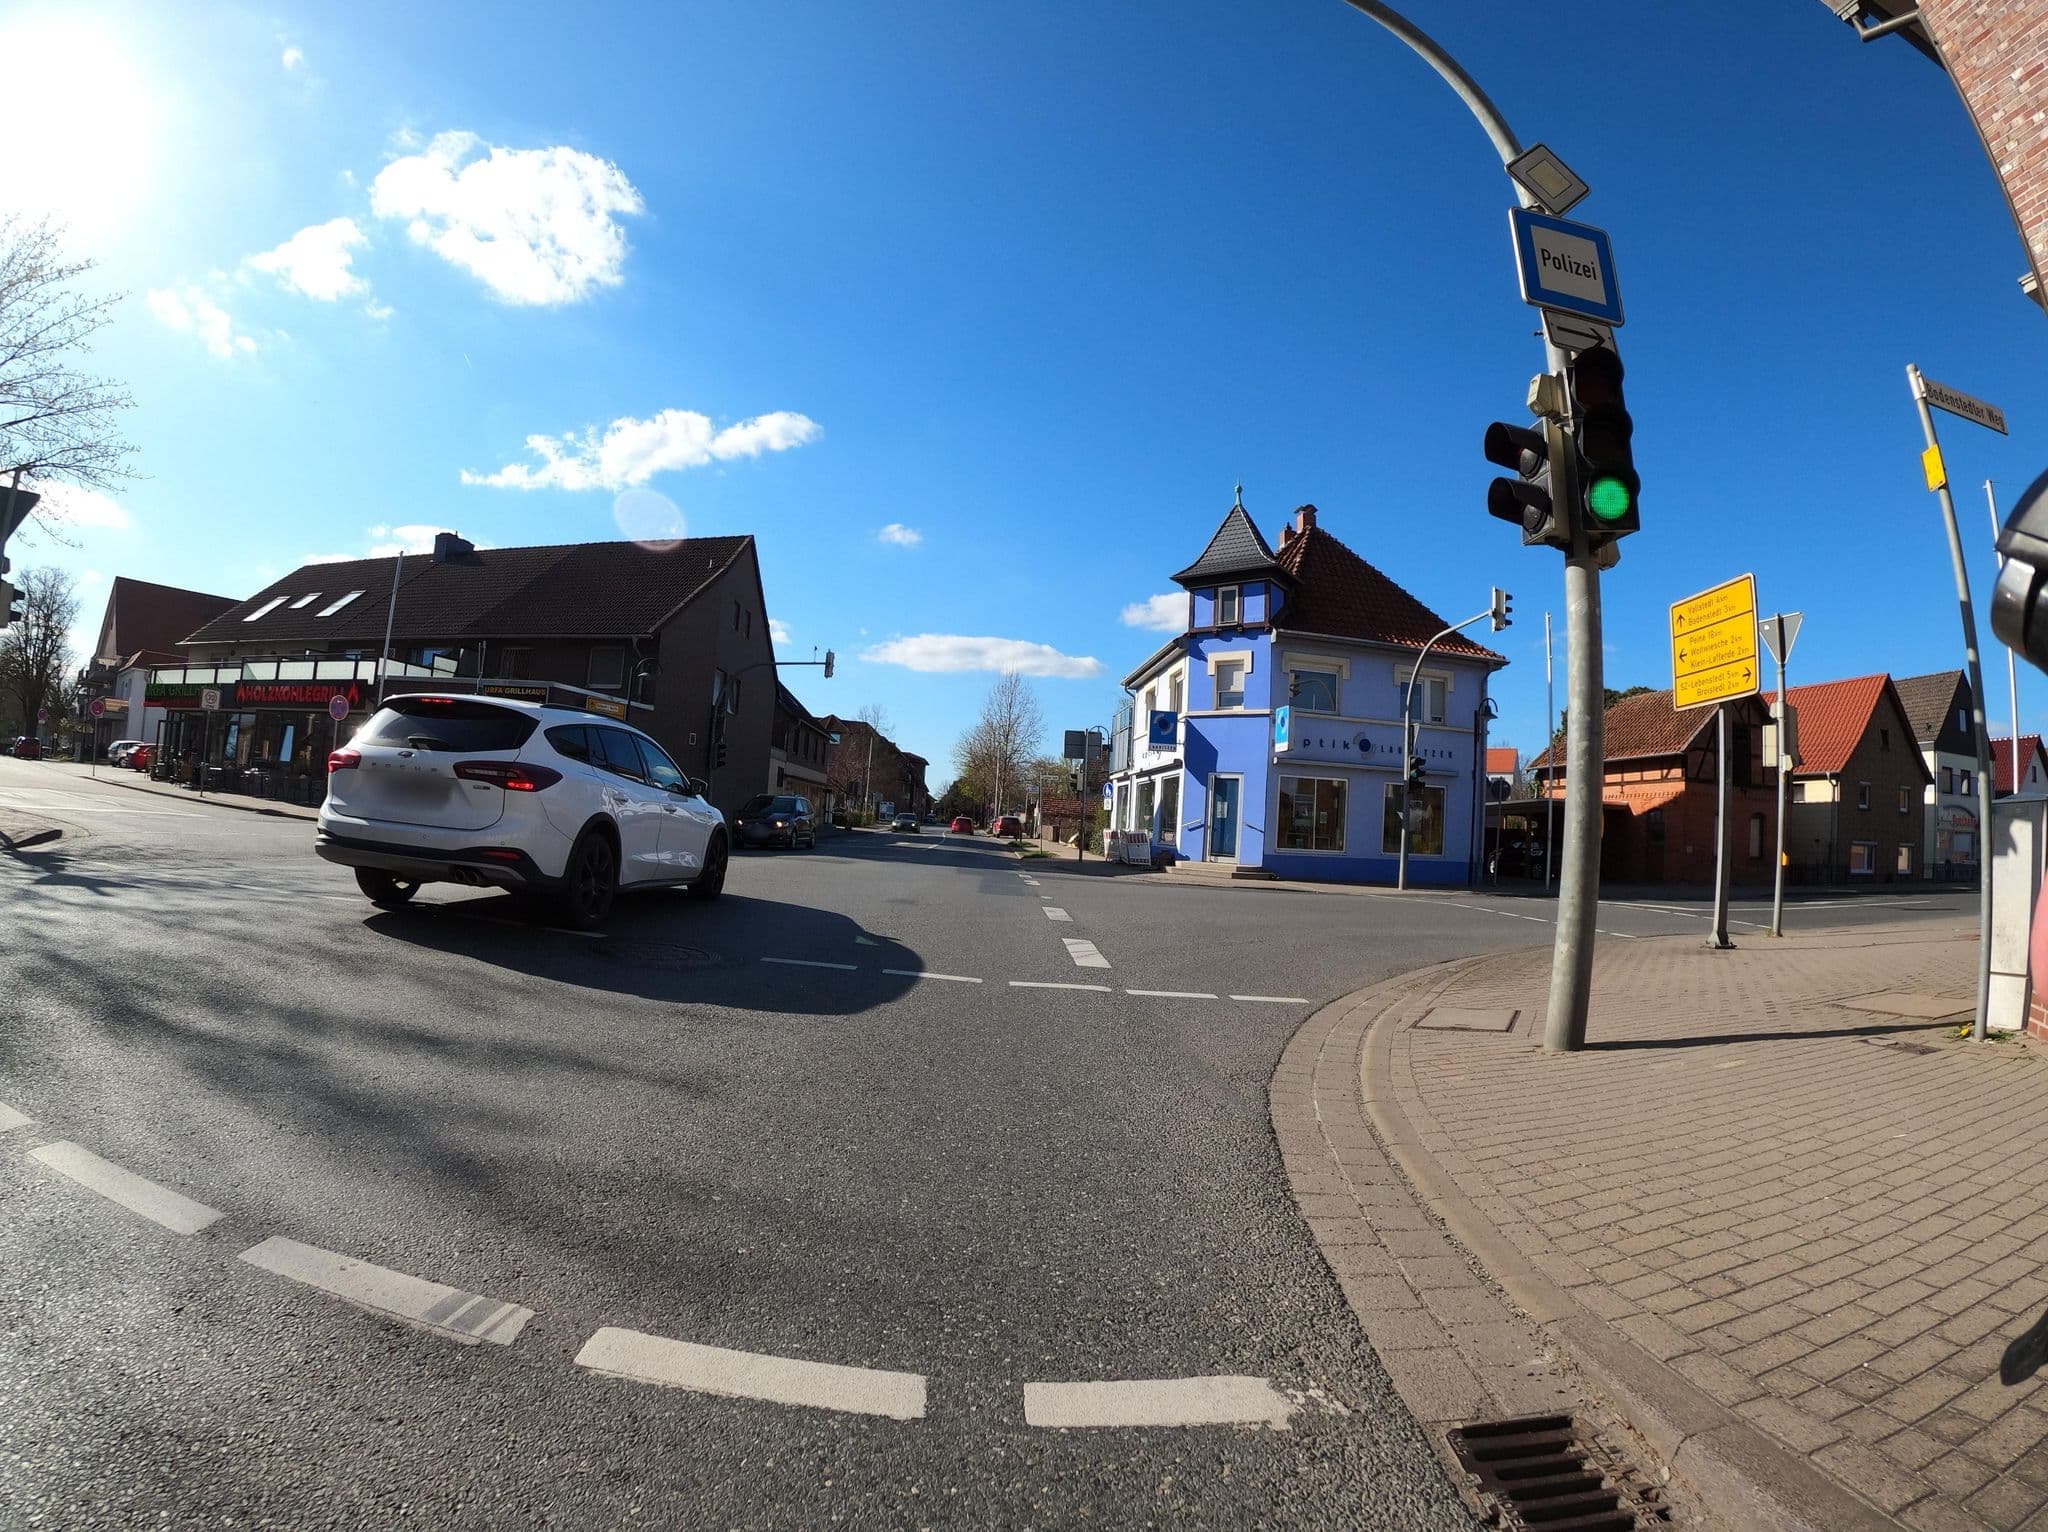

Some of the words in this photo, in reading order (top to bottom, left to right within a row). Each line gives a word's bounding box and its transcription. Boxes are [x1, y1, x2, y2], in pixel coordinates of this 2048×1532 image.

[1540, 247, 1598, 281] Polizei
[1985, 407, 2005, 432] Weg
[1688, 607, 1722, 626] Bodenstedt
